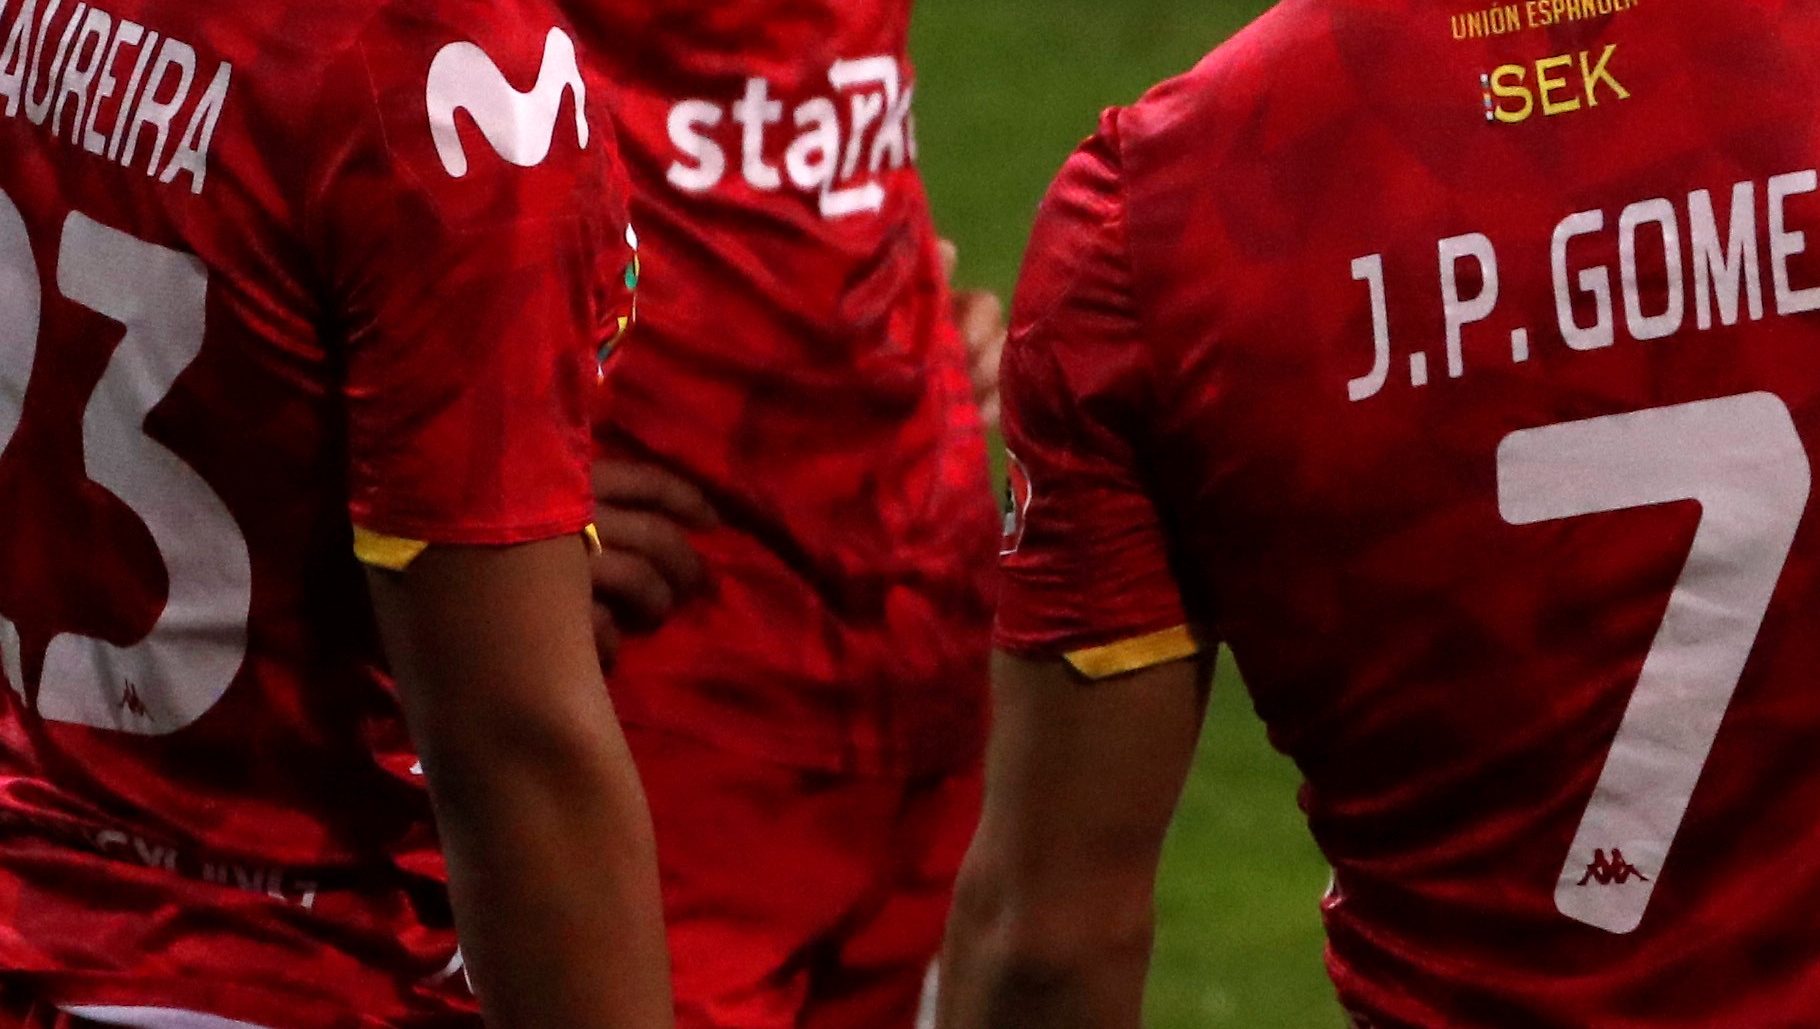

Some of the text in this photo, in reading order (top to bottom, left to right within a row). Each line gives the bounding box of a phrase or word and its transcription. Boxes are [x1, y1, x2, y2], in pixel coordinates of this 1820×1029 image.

[667, 56, 918, 217] stark
[1451, 2, 1521, 40] UNIÓN
[0, 188, 252, 736] 3
[1496, 390, 1811, 936] 7
